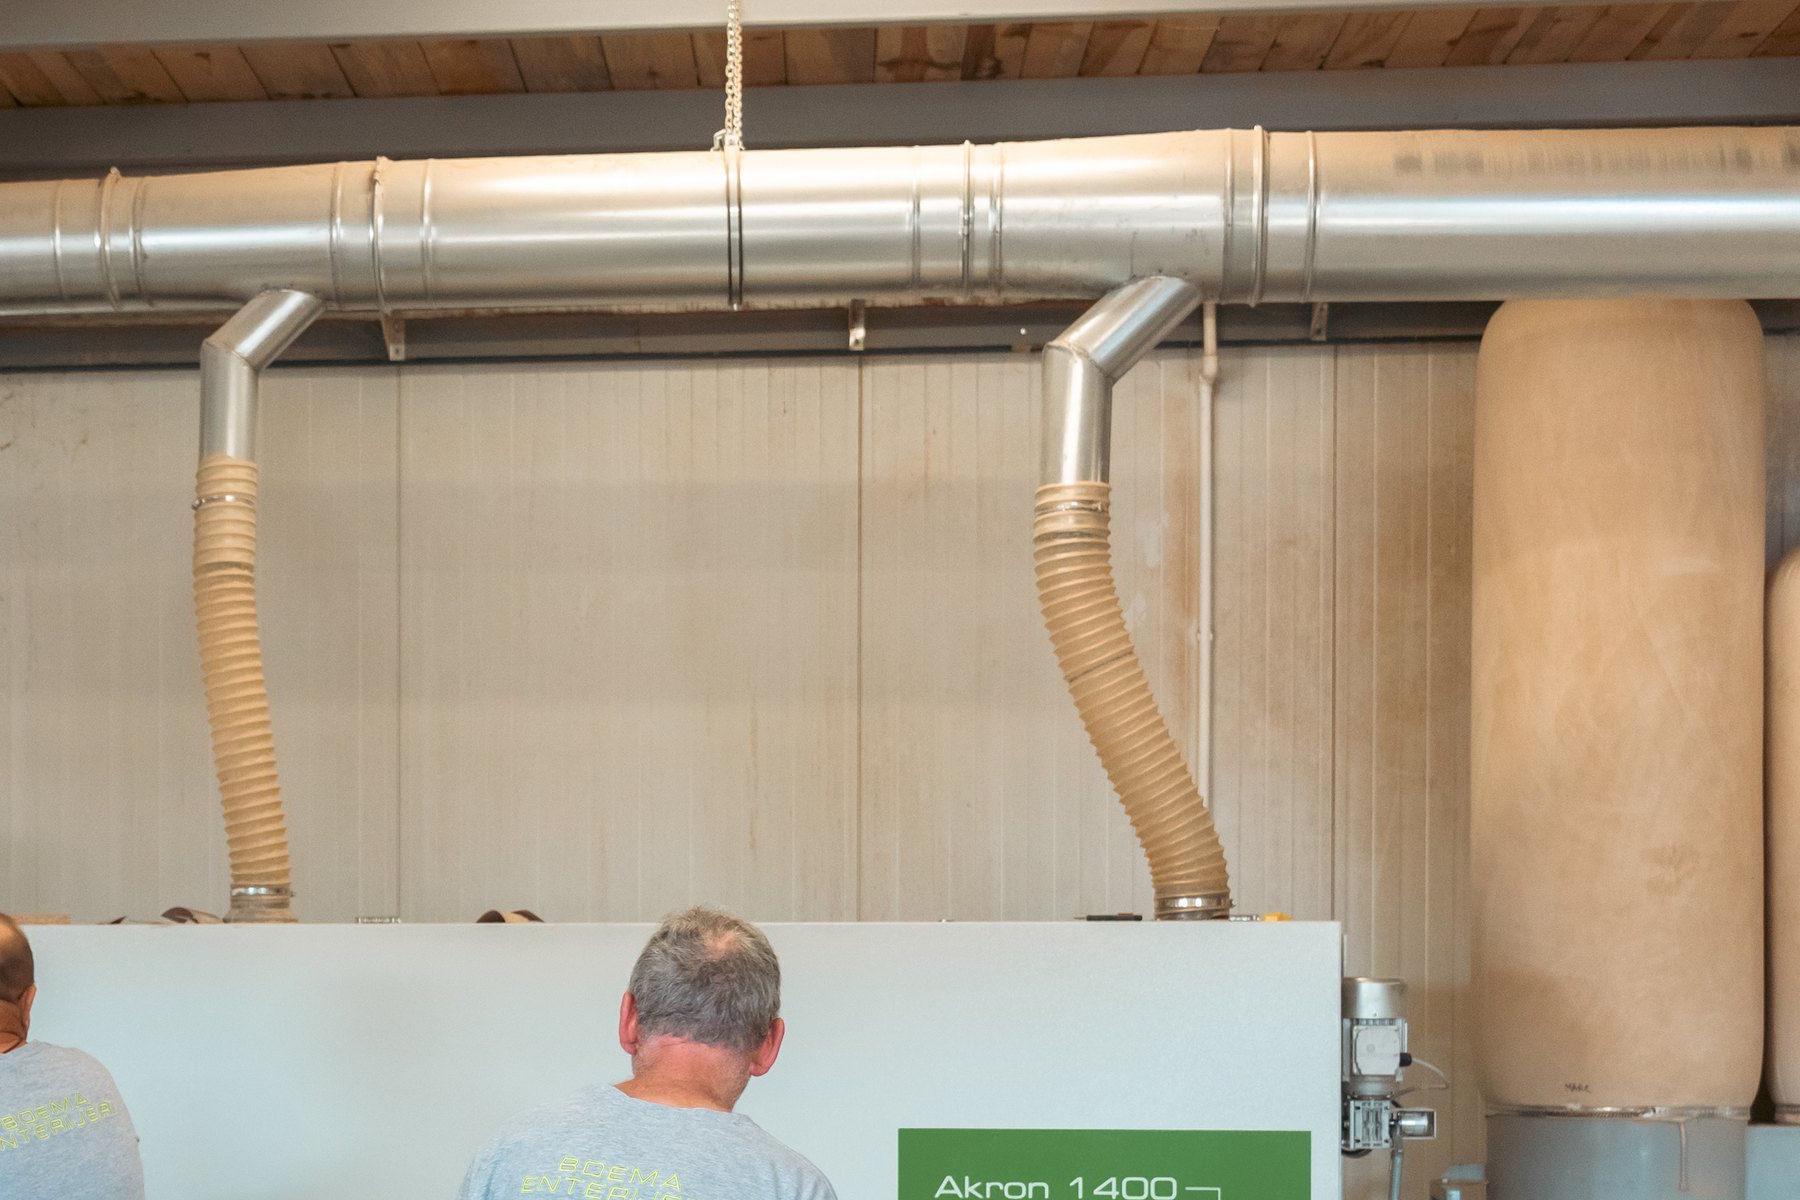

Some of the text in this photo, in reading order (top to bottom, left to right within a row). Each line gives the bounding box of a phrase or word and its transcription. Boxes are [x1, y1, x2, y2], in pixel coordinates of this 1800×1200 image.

[1, 1091, 88, 1130] BOEMA
[558, 1154, 681, 1192] BOEMA
[934, 1175, 1178, 1200] Akron 1400
